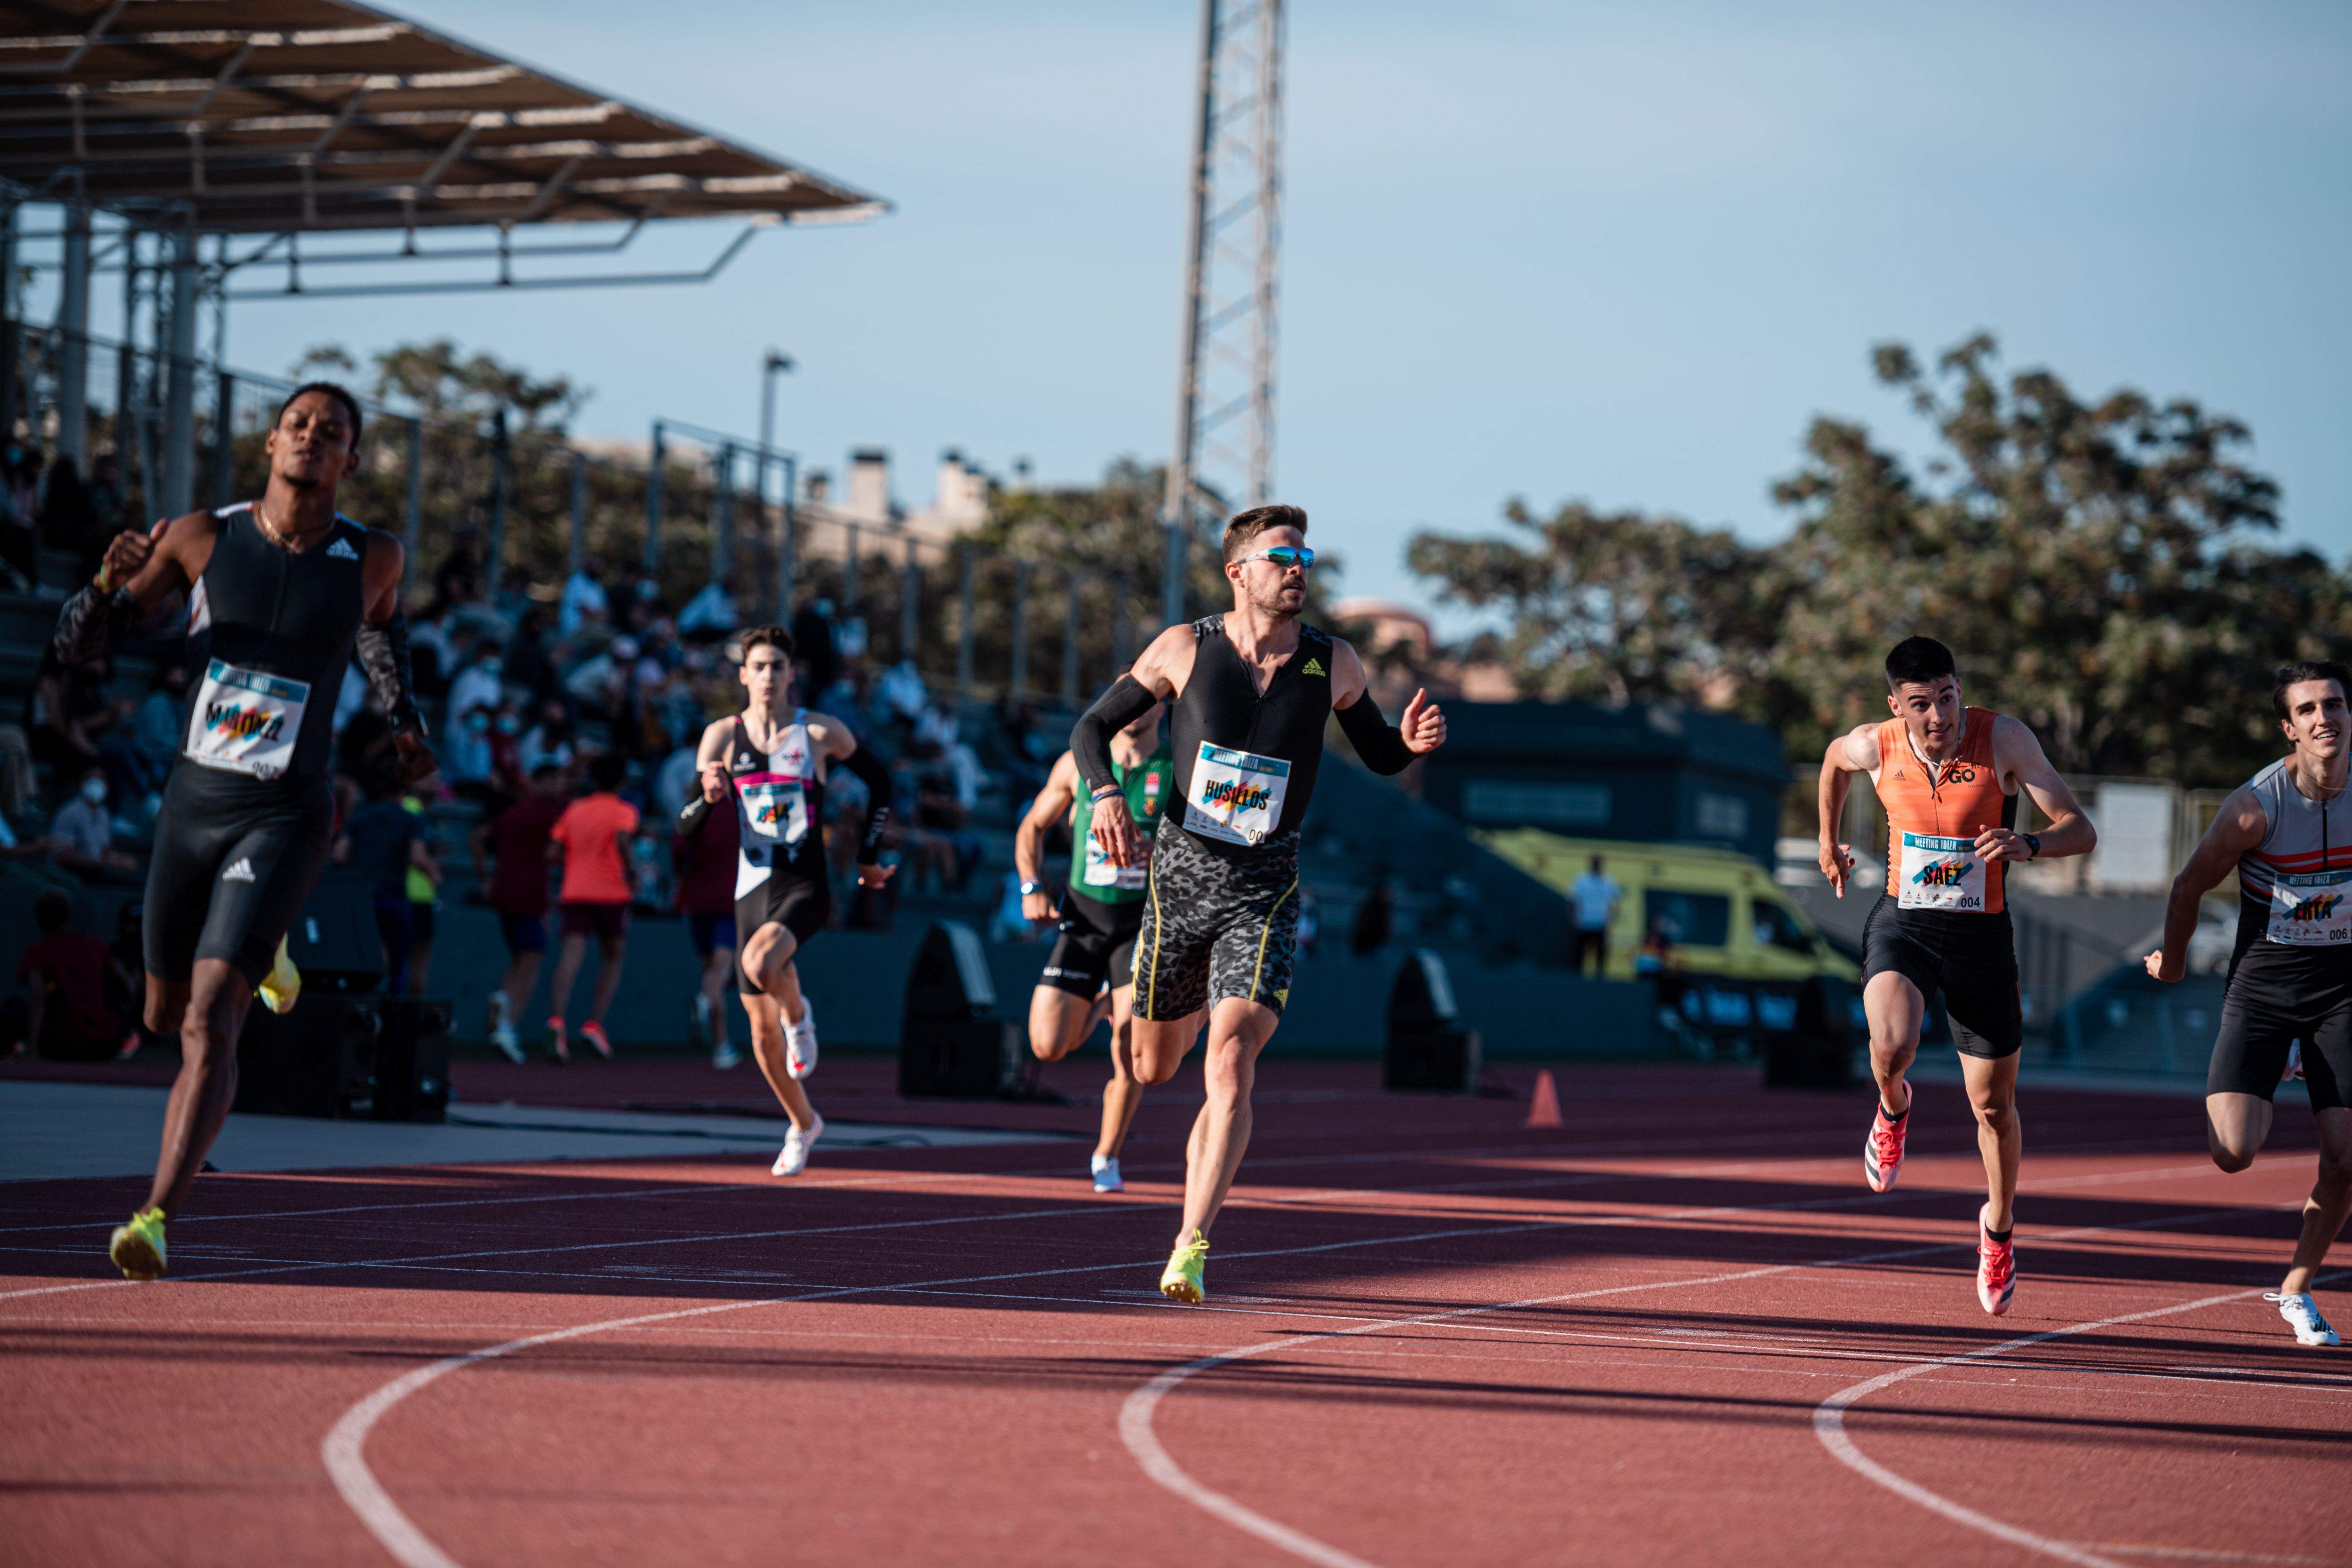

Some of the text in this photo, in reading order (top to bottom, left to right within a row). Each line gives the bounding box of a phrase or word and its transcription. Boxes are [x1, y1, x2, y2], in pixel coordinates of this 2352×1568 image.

[1302, 668, 1326, 677] adidas
[1948, 769, 1975, 783] GO
[1205, 780, 1269, 810] HUSILLOS
[1915, 836, 1957, 851] MEETING IBIZA
[1923, 866, 1963, 886] SAEZ
[2289, 876, 2313, 885] MEETING
[2314, 875, 2330, 884] IBIZA
[1961, 897, 1980, 907] 004
[2330, 928, 2347, 940] 006
